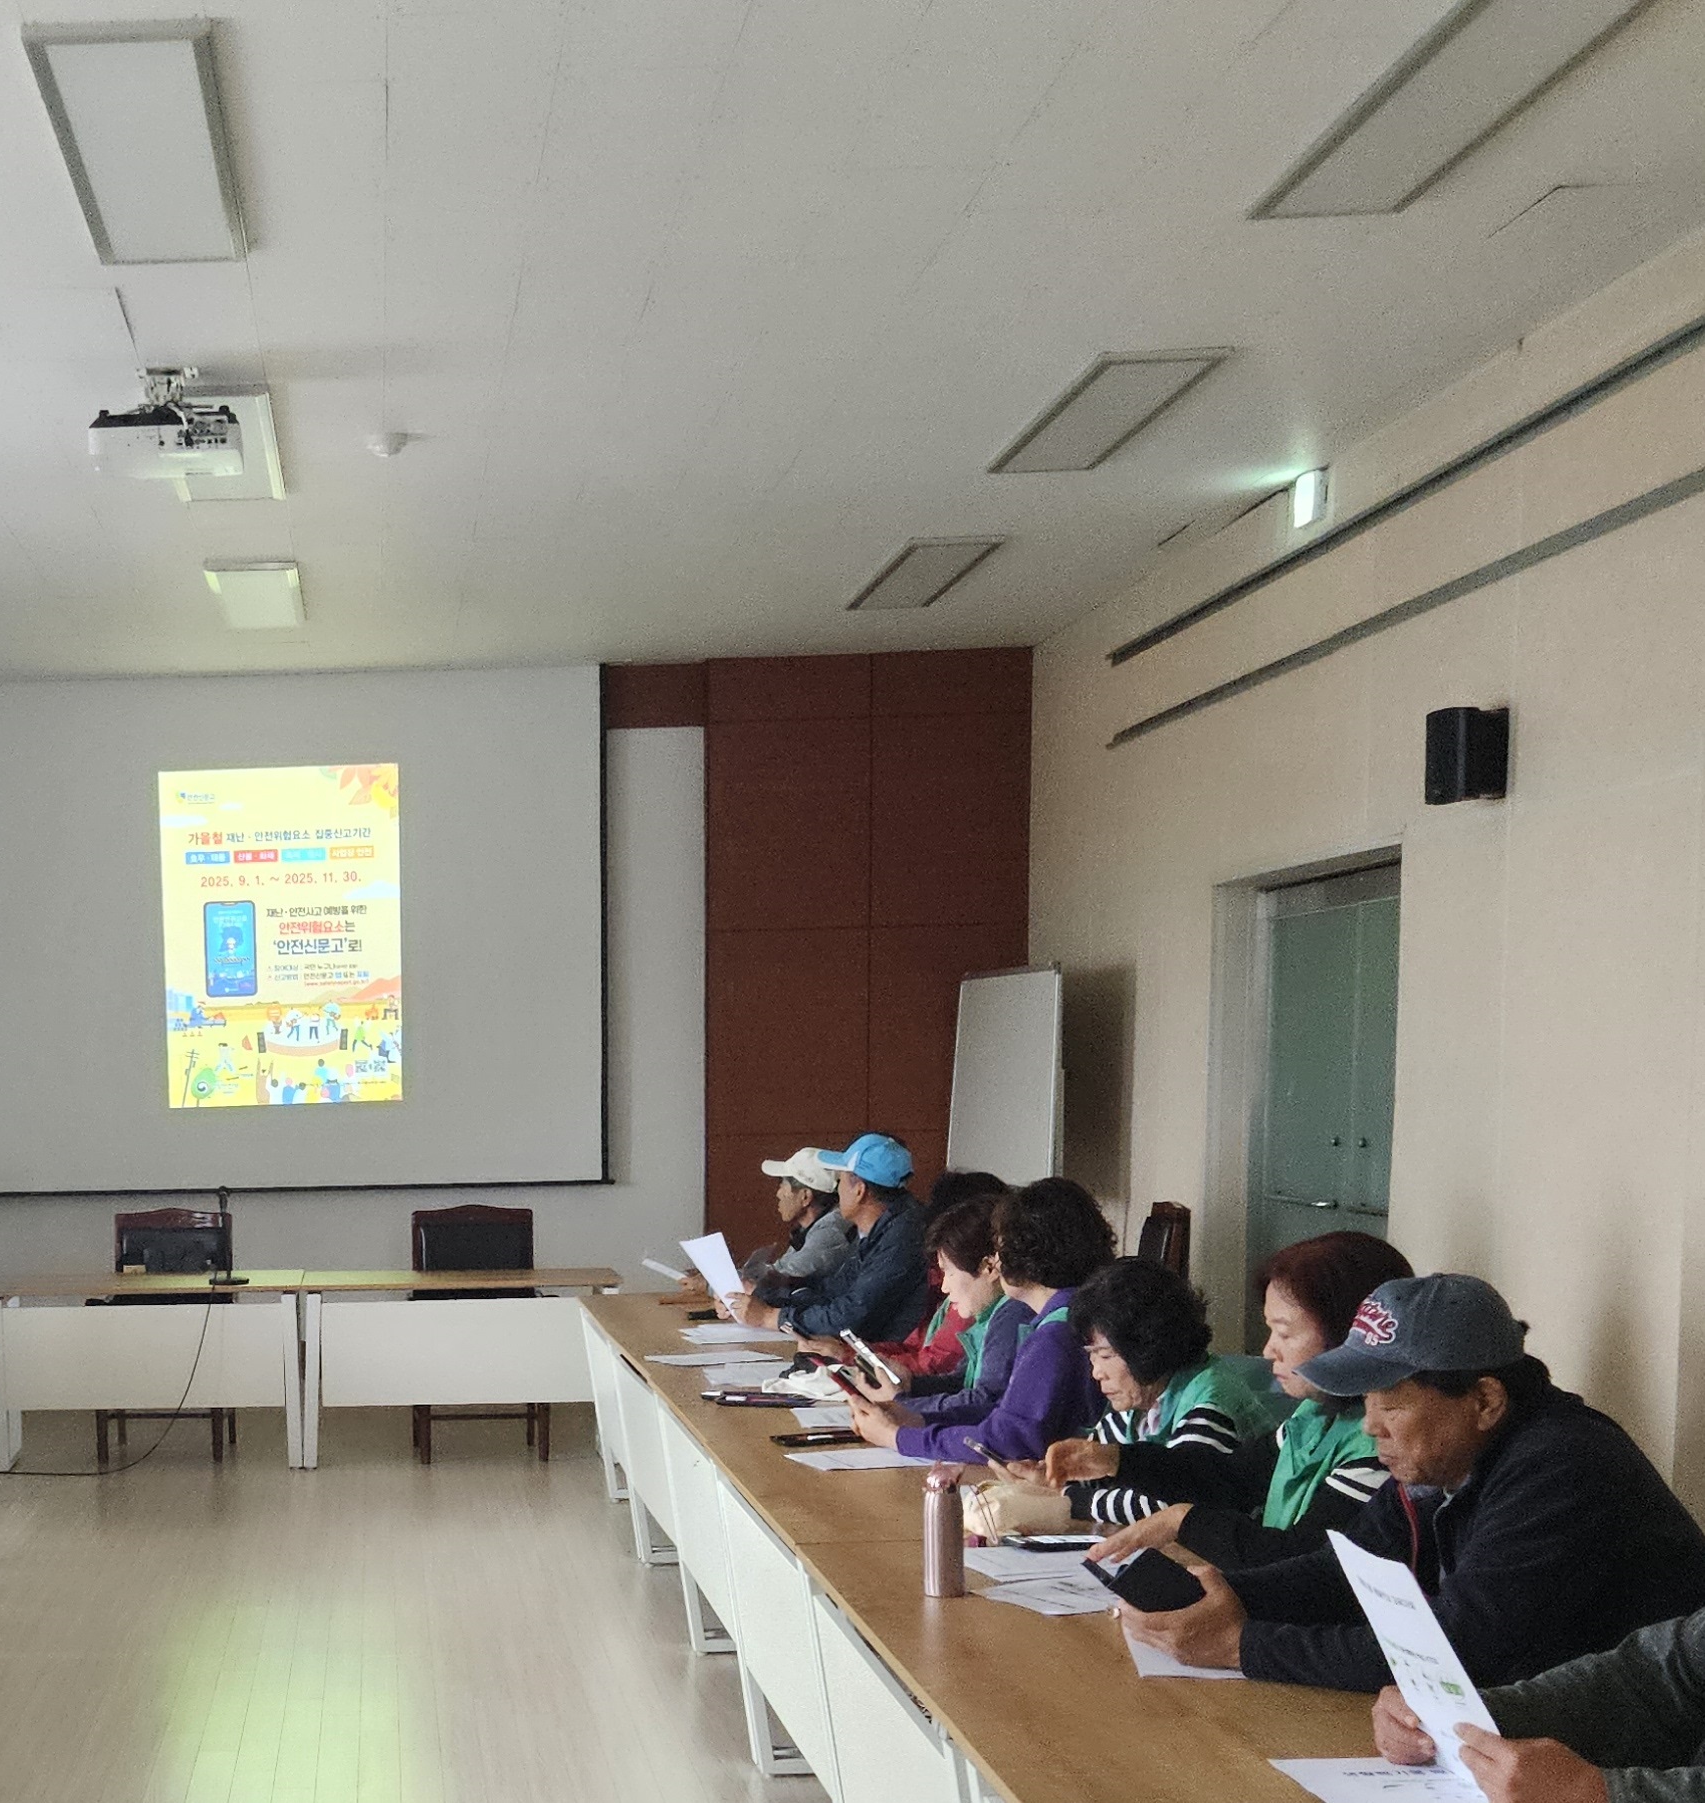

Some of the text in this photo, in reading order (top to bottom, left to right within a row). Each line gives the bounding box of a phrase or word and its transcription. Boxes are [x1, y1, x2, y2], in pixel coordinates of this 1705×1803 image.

[188, 832, 223, 845] 가을철
[226, 832, 244, 843] 재난
[254, 830, 311, 842] 안전위험요소
[315, 827, 371, 840] 집중신고기간
[200, 876, 234, 888] 2025.
[238, 875, 250, 887] 9.
[255, 875, 265, 886] 1.
[284, 873, 318, 885] 2025.
[322, 872, 338, 883] 11.
[342, 871, 362, 882] 30.
[323, 905, 349, 916] 예방을
[350, 904, 368, 915] 위한
[279, 920, 355, 935] 안전위험요소는
